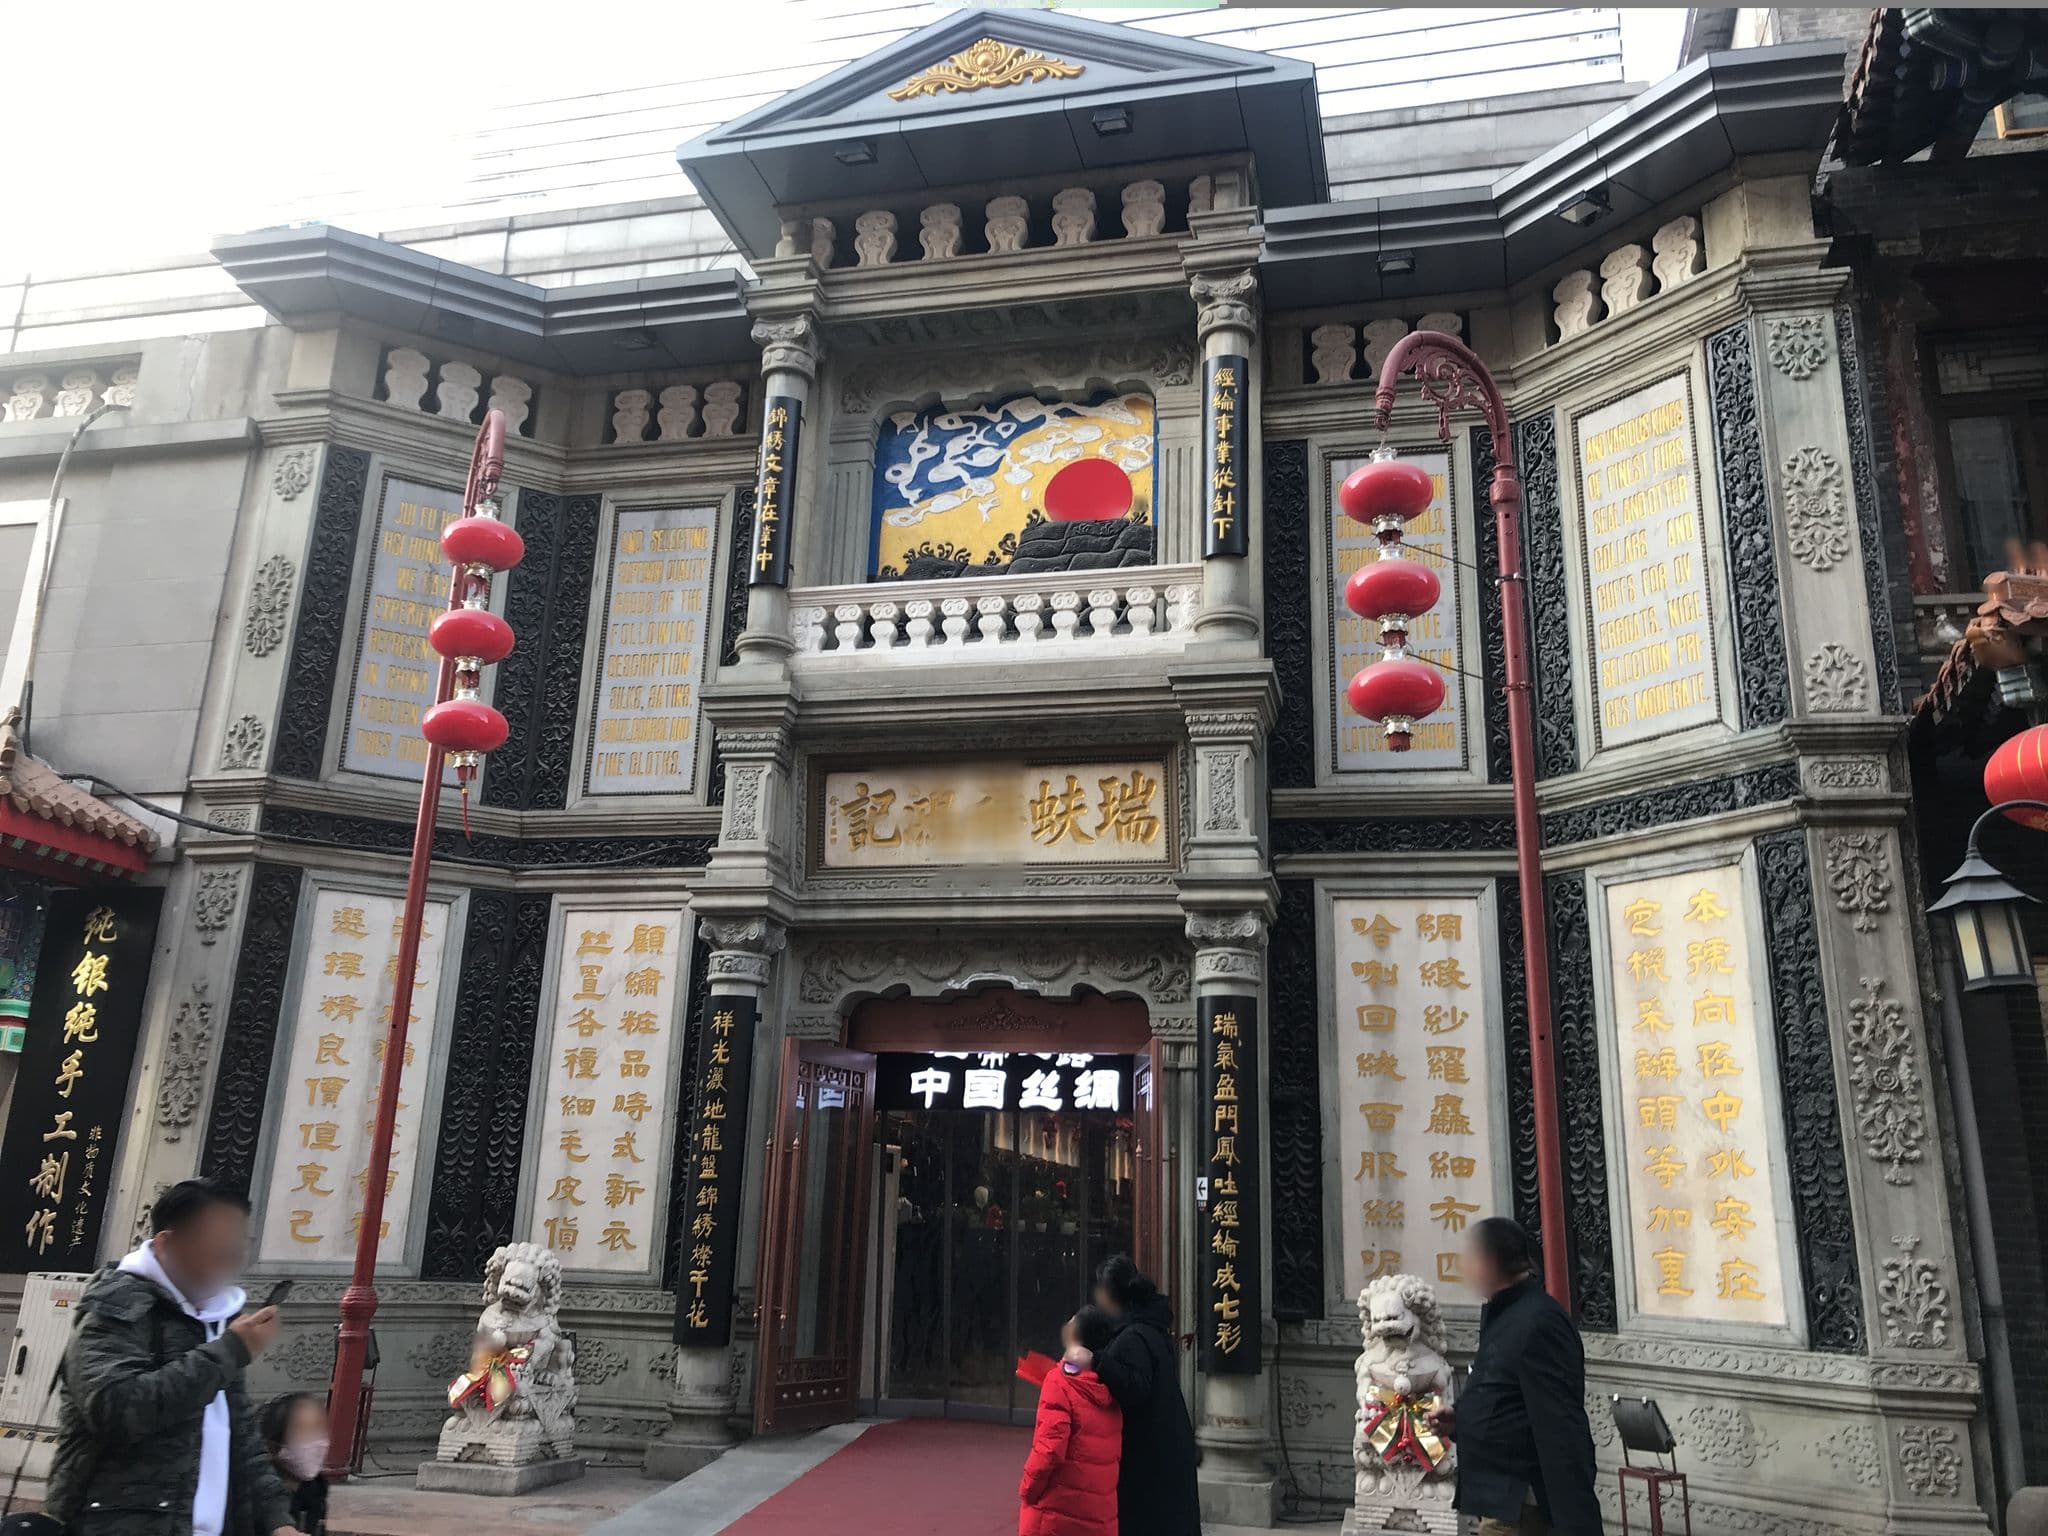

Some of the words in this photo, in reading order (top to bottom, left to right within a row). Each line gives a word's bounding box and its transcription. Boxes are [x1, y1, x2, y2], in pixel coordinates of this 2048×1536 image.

[1604, 412, 1649, 457] VARIOUS
[1587, 472, 1601, 501] OF
[1607, 452, 1649, 491] FINEST
[1592, 503, 1621, 537] SEAL
[1622, 493, 1648, 530] AND
[1647, 473, 1689, 518] OTTER
[651, 527, 709, 553] SELECTING
[1666, 511, 1695, 549] AND
[666, 557, 708, 583] QUALITY
[1641, 562, 1668, 598] FOR
[657, 589, 675, 613] OF
[681, 587, 704, 613] THE
[609, 619, 696, 645] FOLLOWING
[1418, 647, 1454, 675] NEW
[1602, 640, 1671, 689] SELECTION
[594, 751, 625, 778] FINE
[909, 1066, 1121, 1112] 中国丝绸
